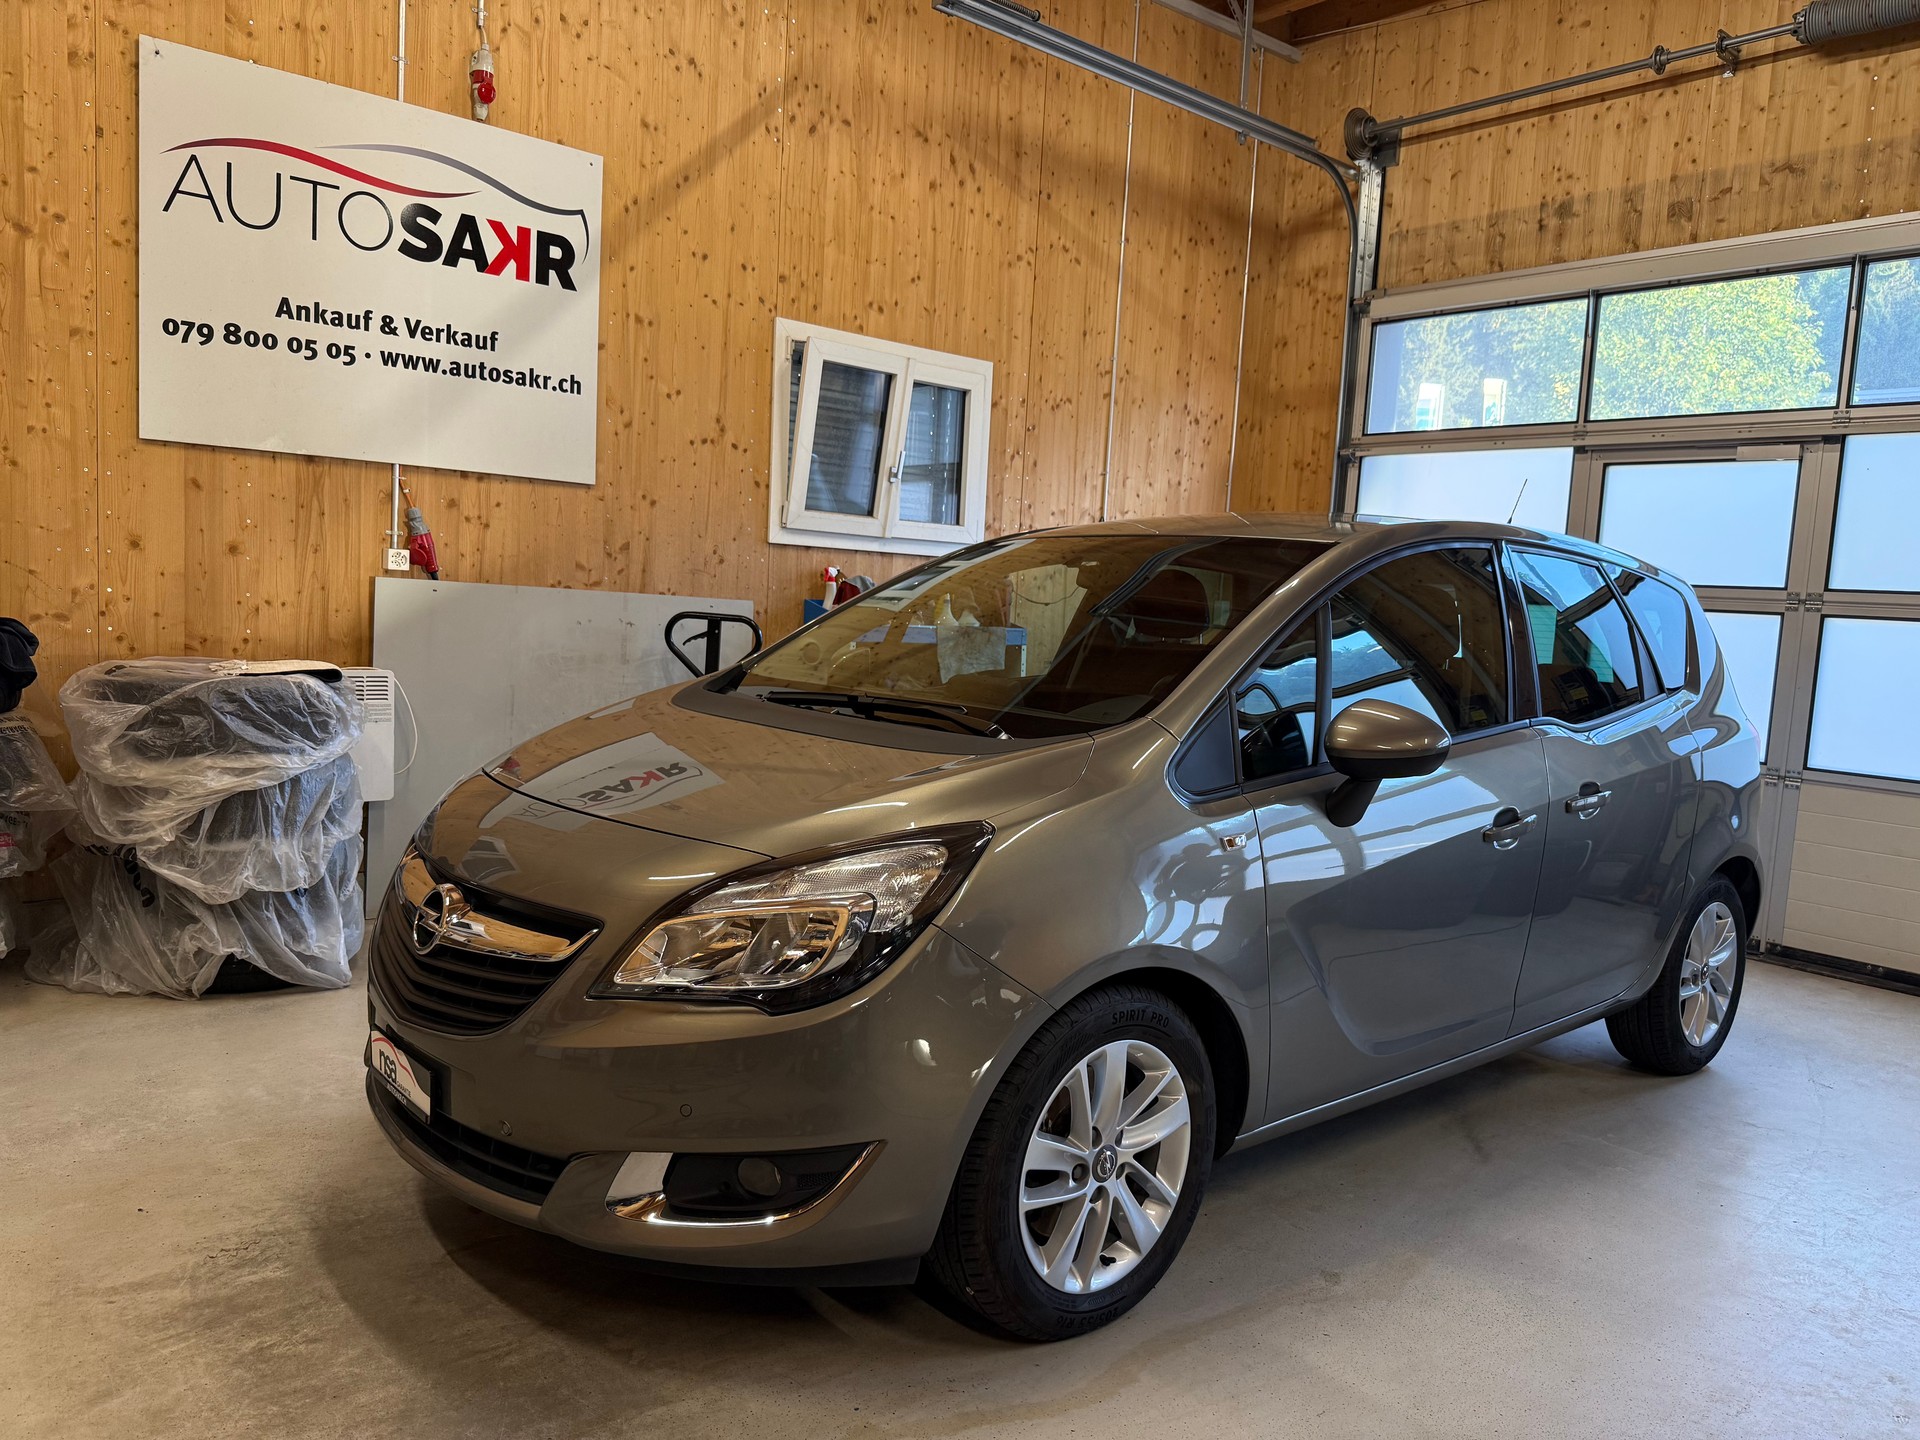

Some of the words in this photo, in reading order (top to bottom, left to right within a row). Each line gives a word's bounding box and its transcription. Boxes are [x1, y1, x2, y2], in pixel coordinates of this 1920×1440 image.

[275, 296, 373, 332] Ankauf
[379, 314, 400, 337] &
[403, 316, 499, 352] Verkauf
[161, 317, 215, 347] 079
[222, 322, 279, 351] 800
[286, 336, 318, 361] 05
[326, 342, 357, 367] 05
[379, 350, 582, 396] www.autosakr.ch
[1111, 1007, 1148, 1025] SPIRIT
[1150, 1012, 1170, 1029] PRO
